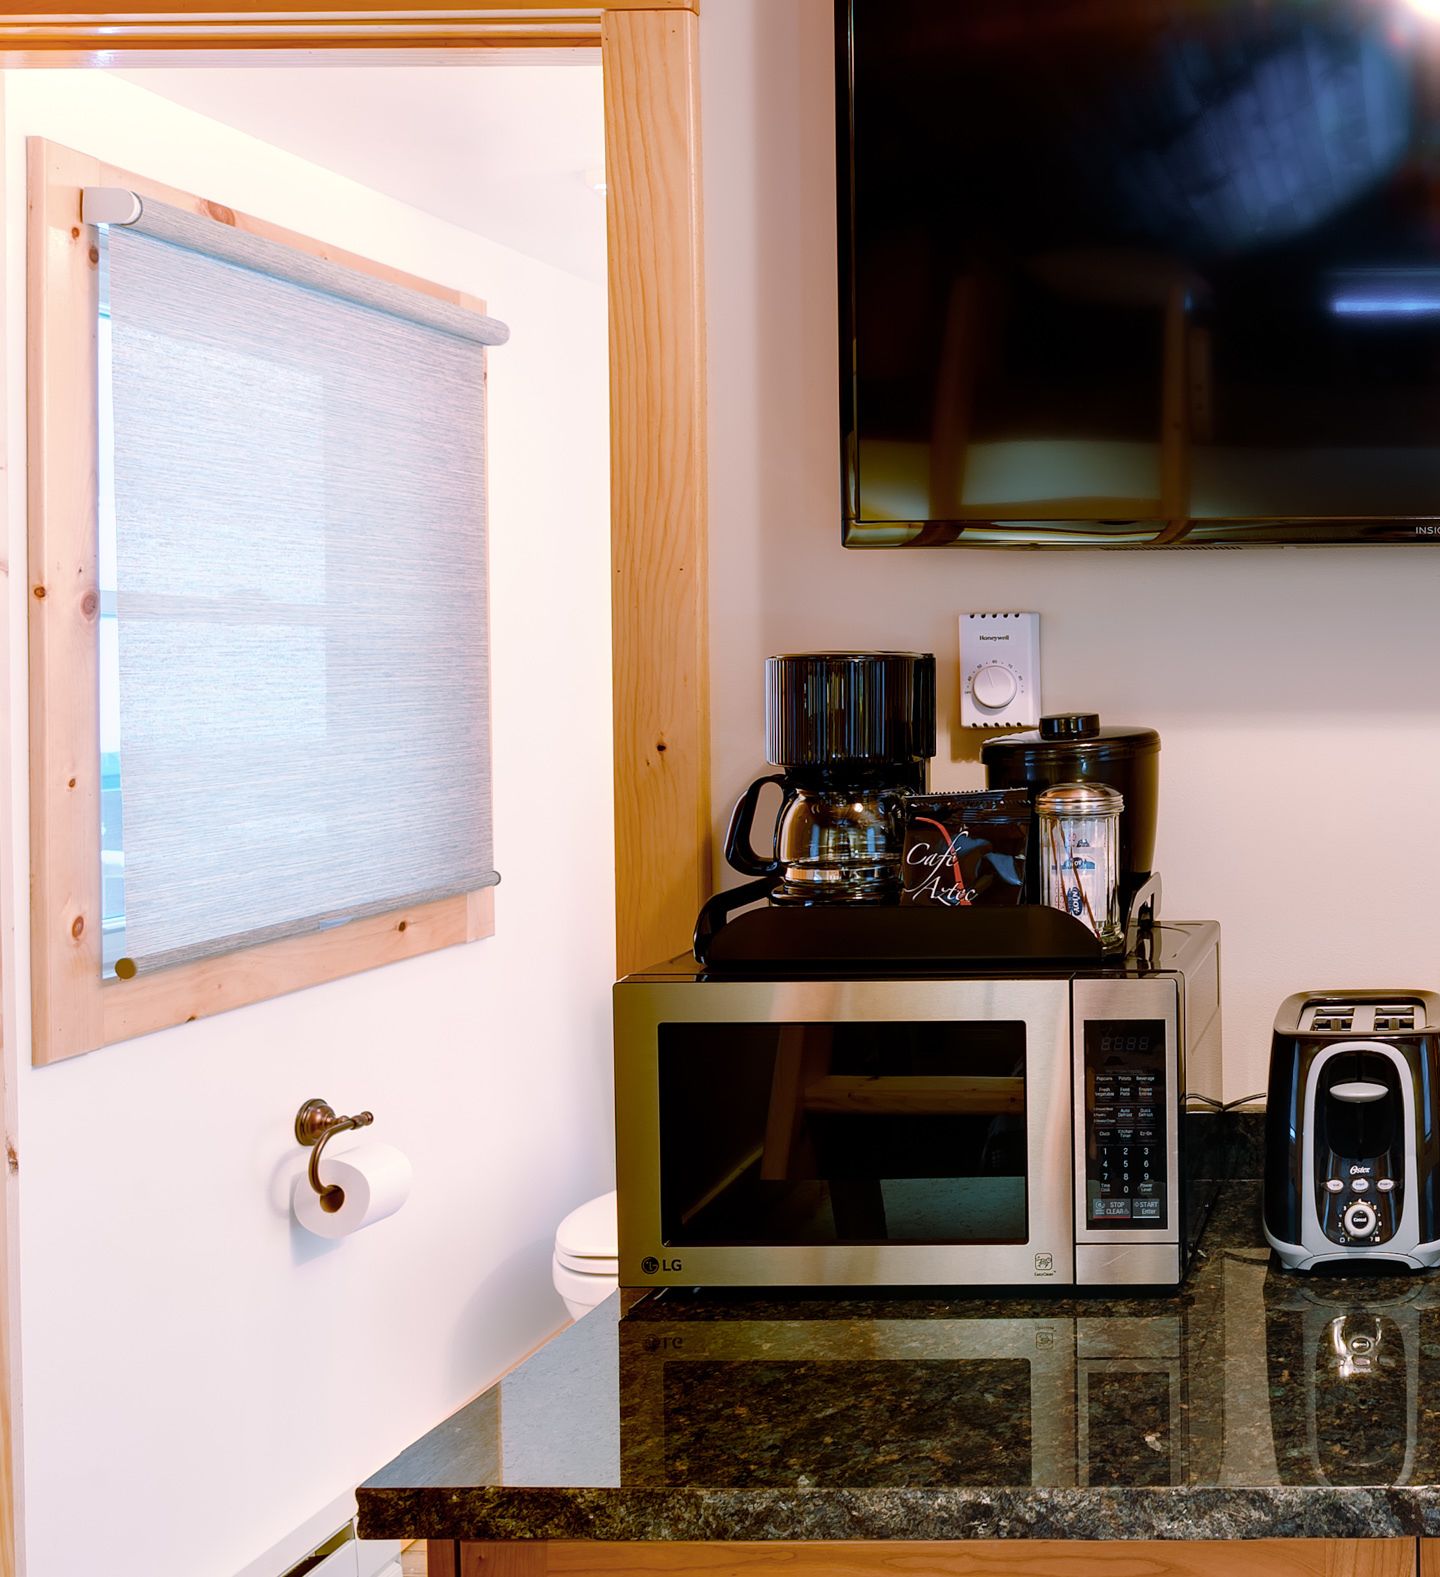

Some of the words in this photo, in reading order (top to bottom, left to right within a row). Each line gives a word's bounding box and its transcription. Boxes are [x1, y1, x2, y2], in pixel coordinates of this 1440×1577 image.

[912, 875, 979, 907] Aztec
[1103, 1147, 1108, 1155] 1
[1123, 1147, 1128, 1155] 2
[1144, 1147, 1149, 1155] 3
[1103, 1160, 1108, 1168] 4
[1123, 1160, 1128, 1168] 5
[1144, 1160, 1149, 1168] 6
[1350, 1165, 1371, 1175] Oster
[1123, 1185, 1129, 1193] 0
[662, 1259, 682, 1272] LG
